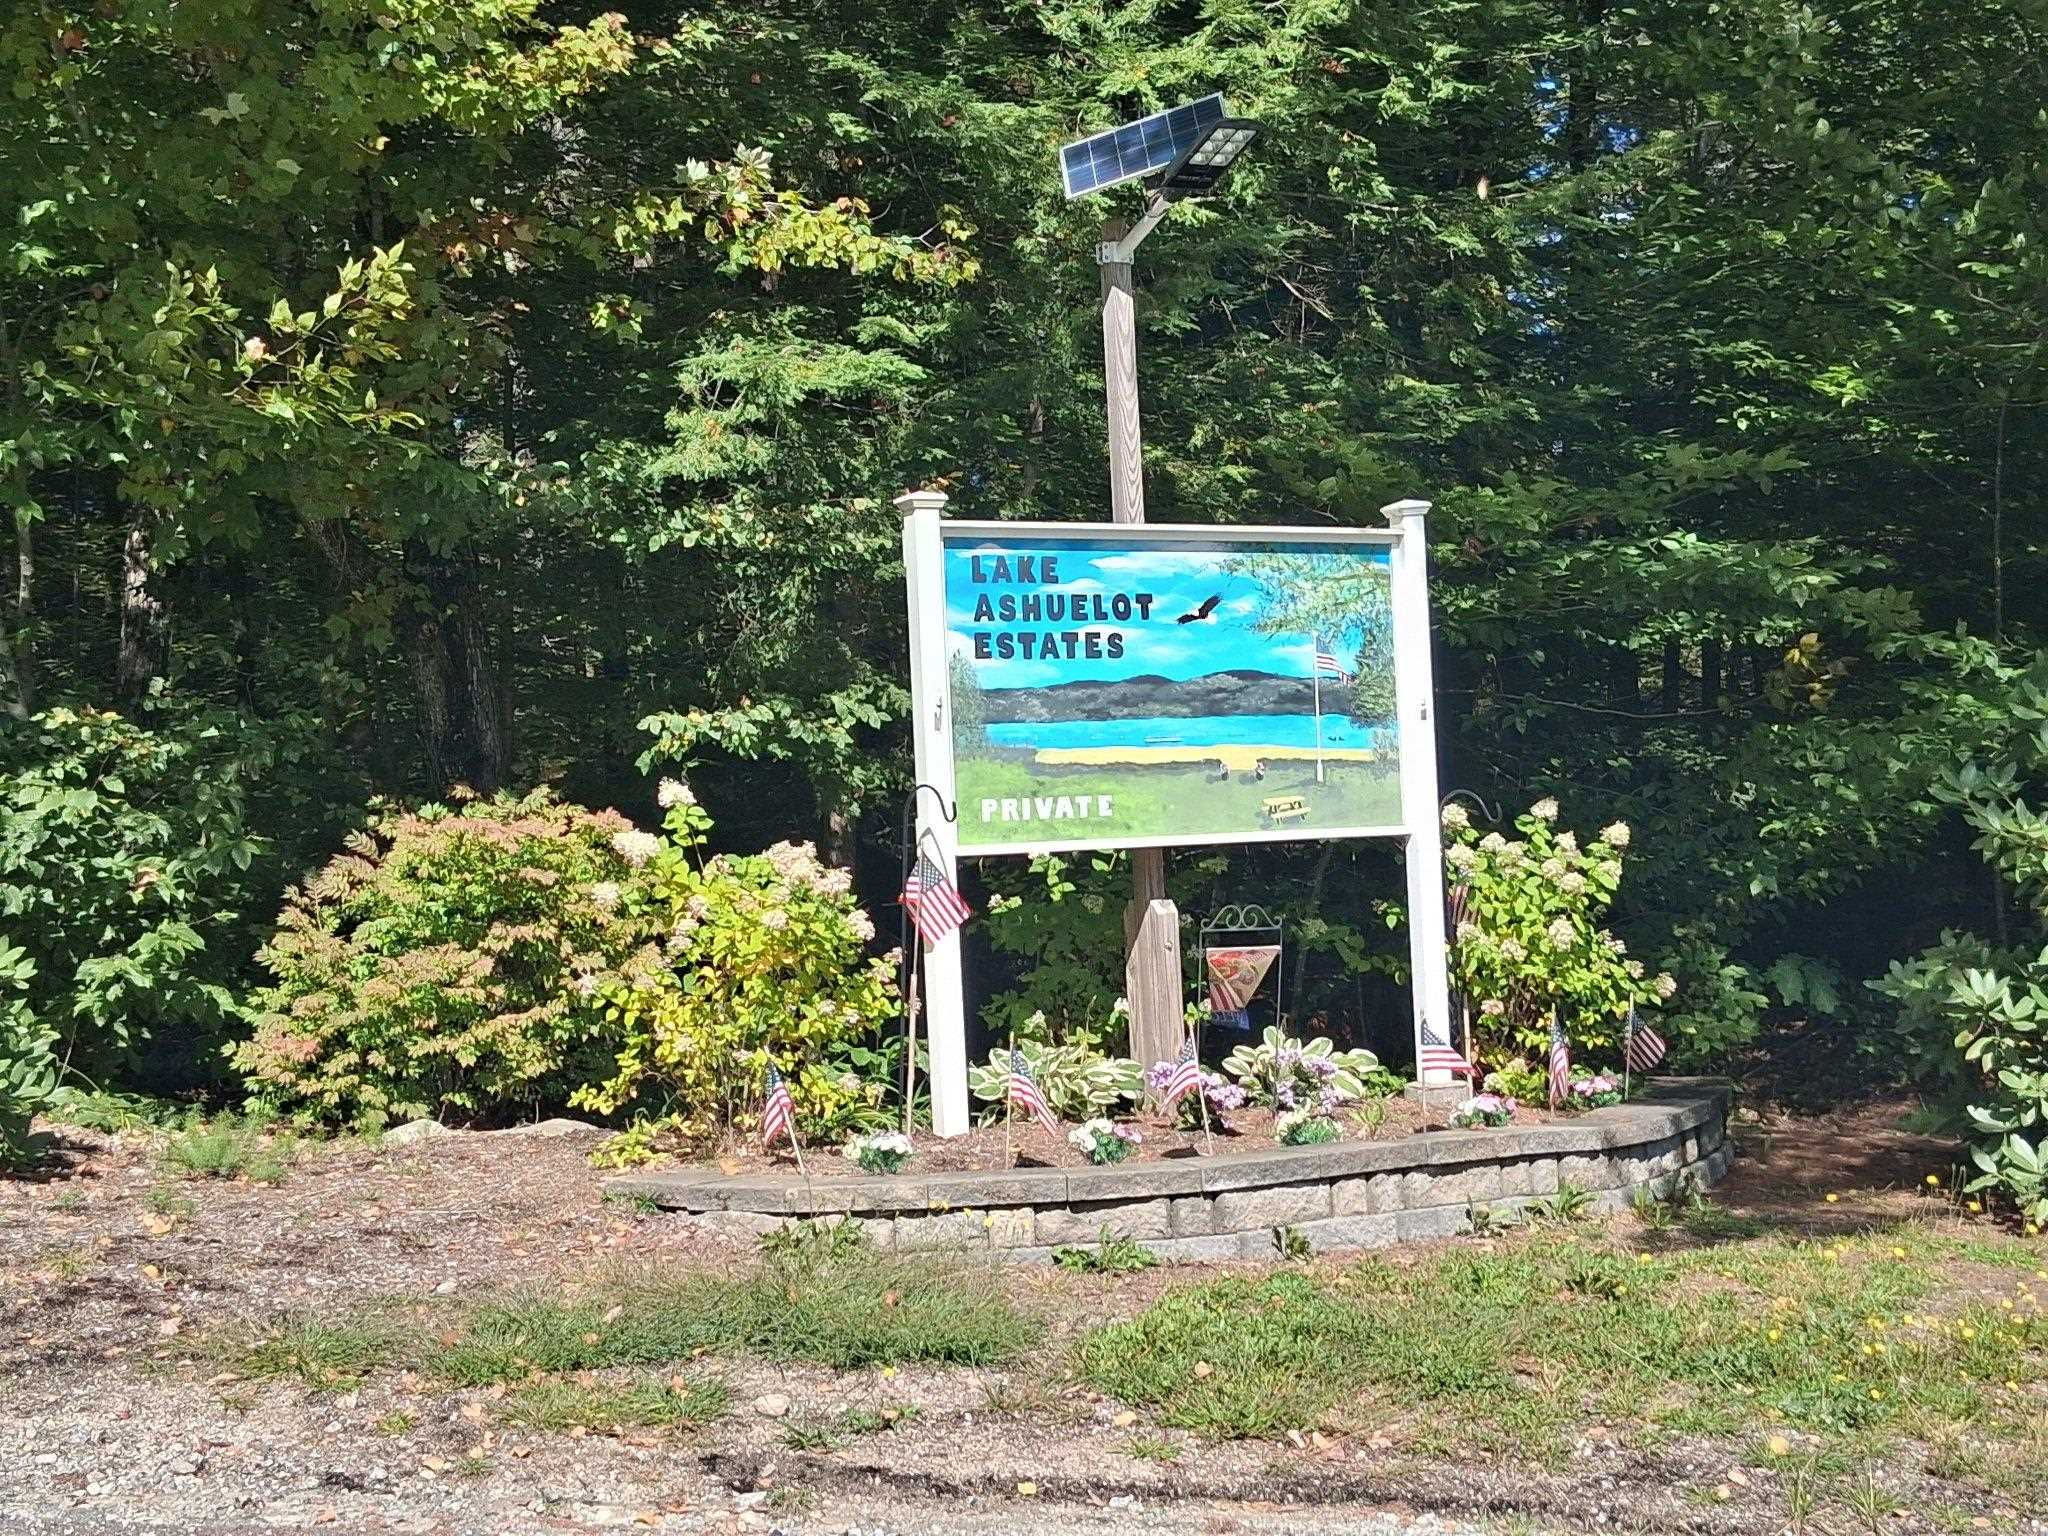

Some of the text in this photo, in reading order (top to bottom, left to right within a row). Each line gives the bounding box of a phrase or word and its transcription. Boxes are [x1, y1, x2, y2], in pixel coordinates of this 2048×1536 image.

[971, 555, 1059, 584] LAKE
[974, 593, 1153, 622] ASHUELOT
[974, 632, 1124, 660] ESTATES
[981, 795, 1113, 822] PRIVATE
